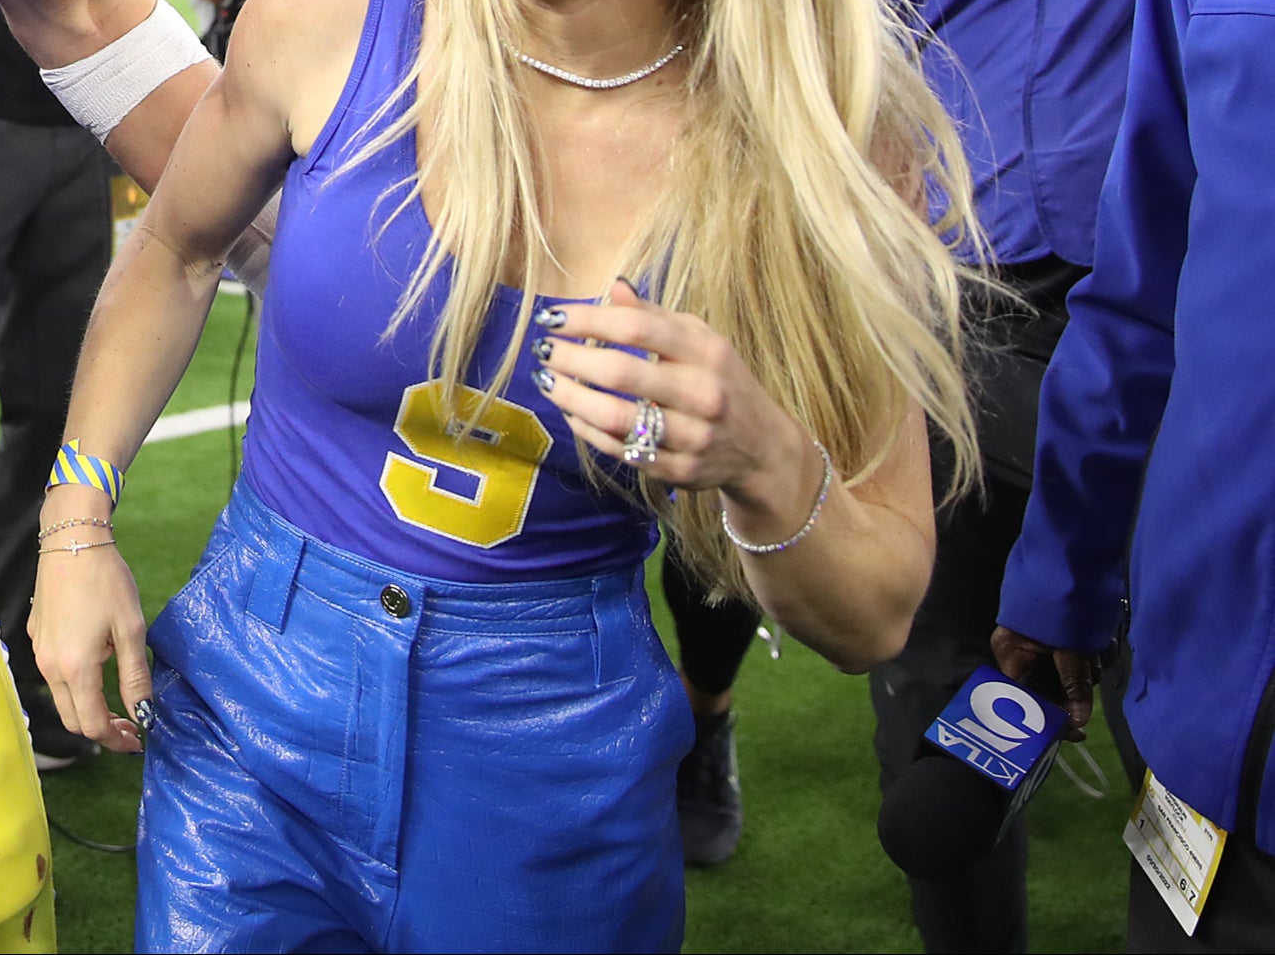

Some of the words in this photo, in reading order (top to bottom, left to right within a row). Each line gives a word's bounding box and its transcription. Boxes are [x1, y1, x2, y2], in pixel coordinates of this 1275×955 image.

[380, 378, 554, 549] 9
[956, 681, 1046, 753] 5
[937, 724, 1019, 786] KTLA
[1138, 818, 1145, 829] 1
[1179, 877, 1187, 891] 6
[1189, 890, 1196, 903] 7
[1165, 816, 1189, 851] FRANCISCO
